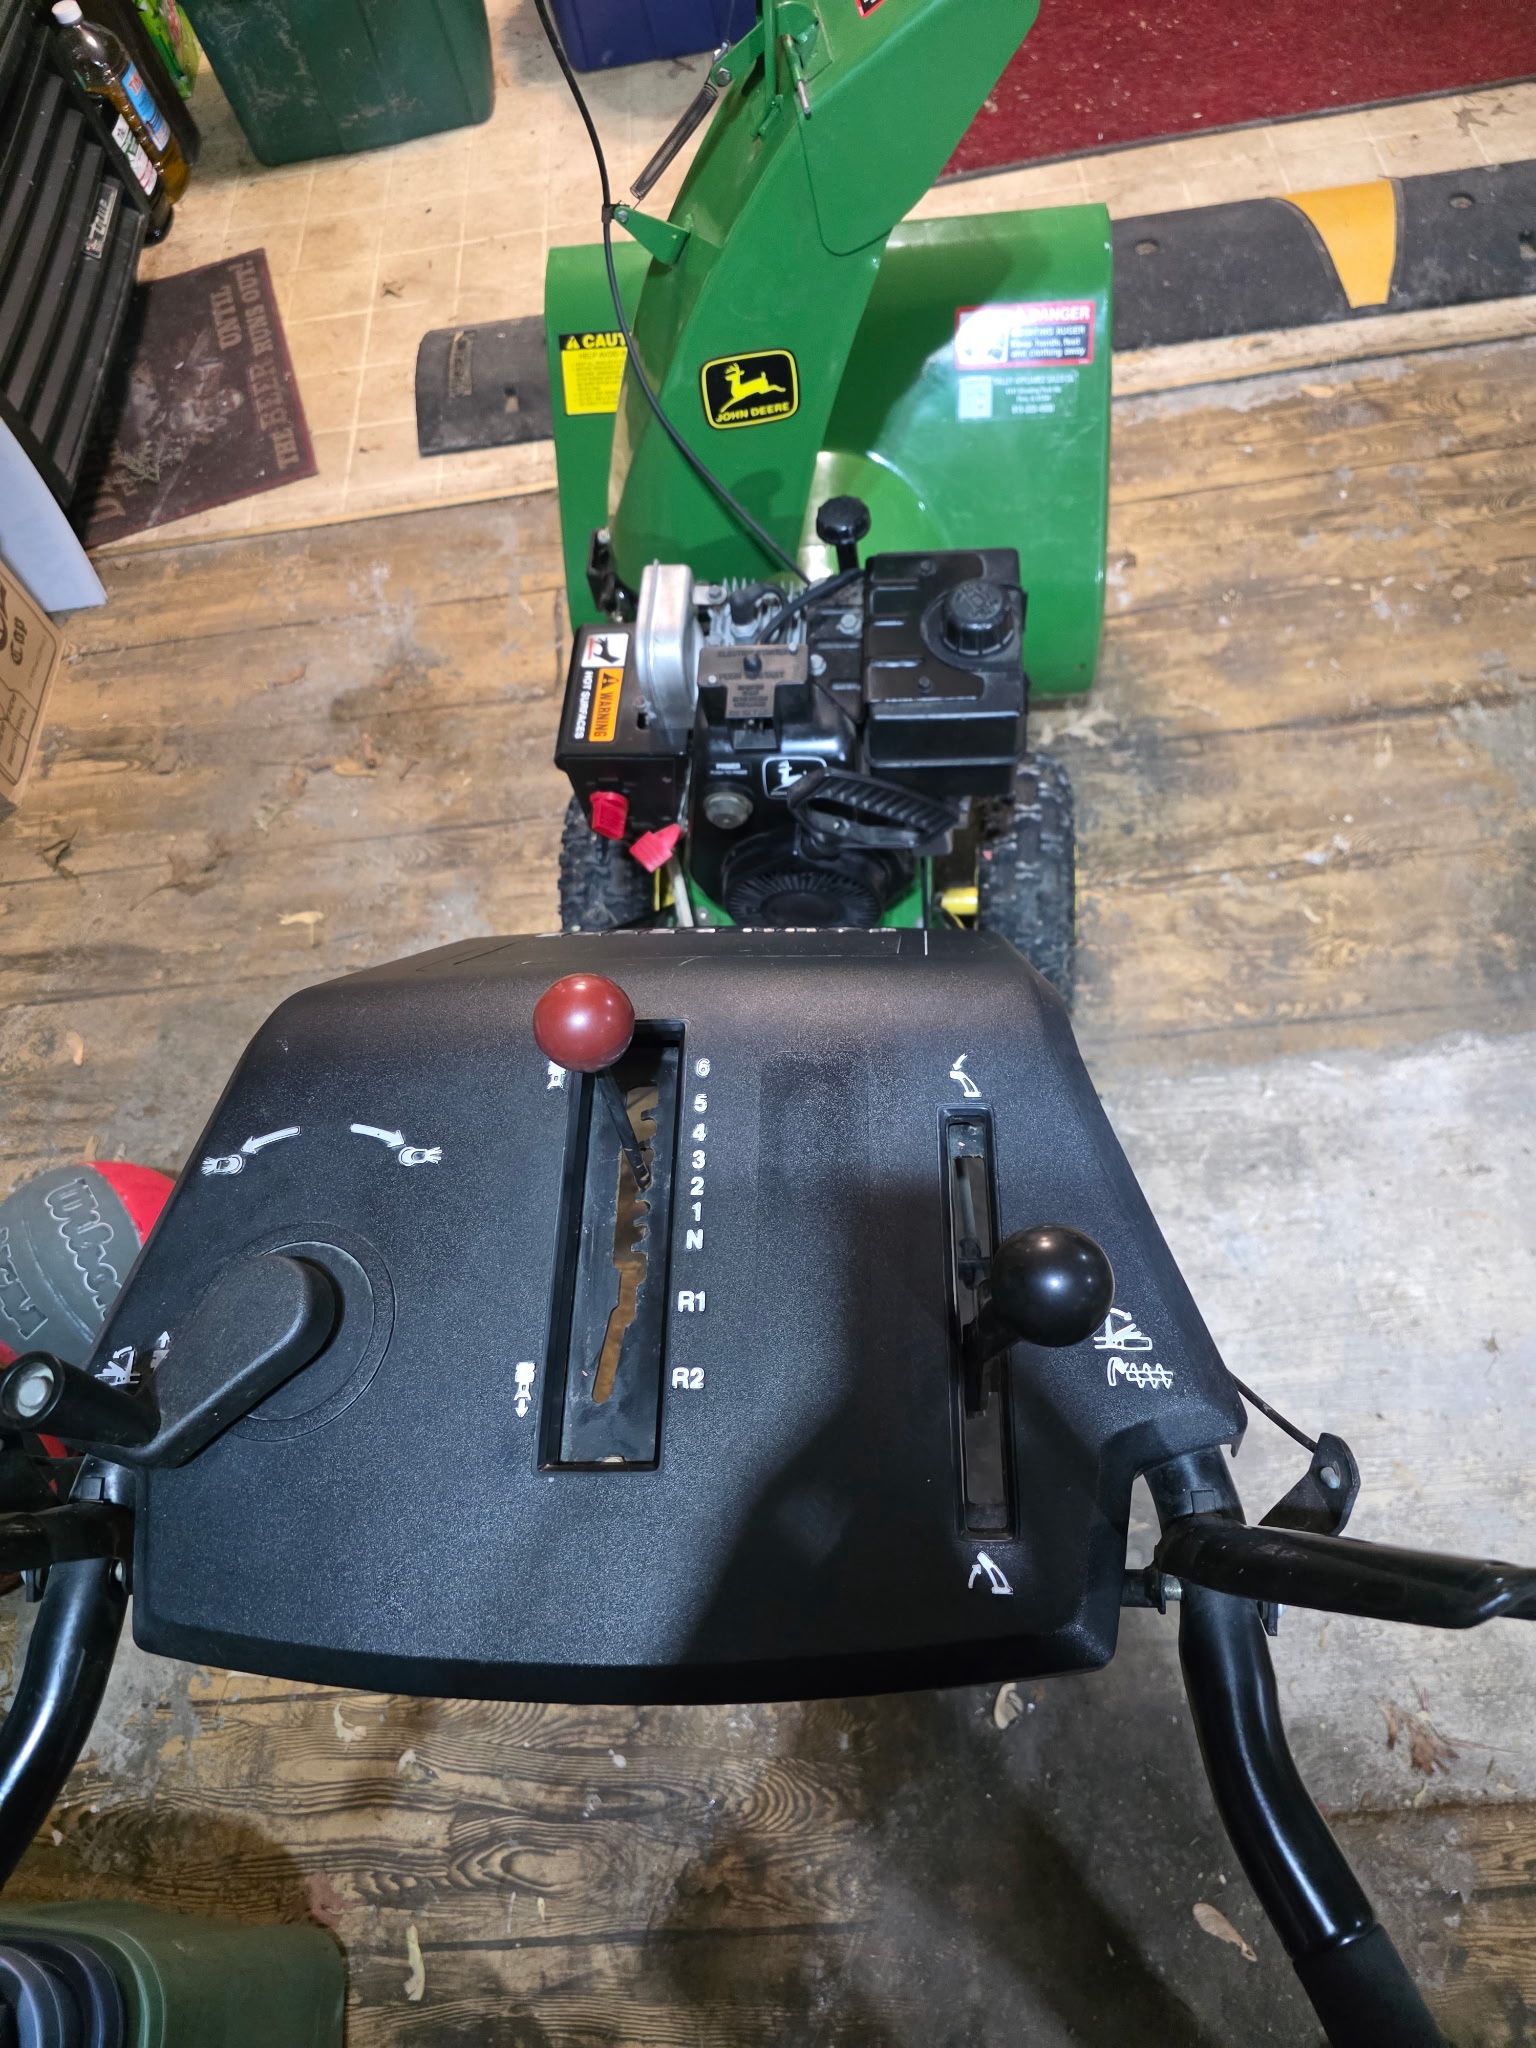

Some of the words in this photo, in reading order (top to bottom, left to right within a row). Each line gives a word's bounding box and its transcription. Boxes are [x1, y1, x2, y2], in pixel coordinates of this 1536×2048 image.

[210, 284, 242, 351] UNTIL
[1026, 305, 1091, 322] DANGER
[244, 304, 274, 356] RUNS
[582, 332, 626, 349] CAUT
[249, 357, 288, 431] BEER
[715, 408, 749, 423] JOHN
[749, 401, 790, 417] DEERE
[271, 428, 299, 470] THE
[582, 670, 594, 691] HOT
[574, 690, 591, 739] SURFACES
[594, 692, 614, 737] WARNING
[696, 1058, 711, 1078] 6
[693, 1093, 708, 1113] 5
[691, 1122, 707, 1141] 4
[691, 1149, 706, 1170] 3
[690, 1176, 706, 1196] 2
[692, 1201, 702, 1222] 1
[685, 1228, 705, 1250] N
[676, 1290, 706, 1313] R1
[671, 1366, 705, 1389] R2
